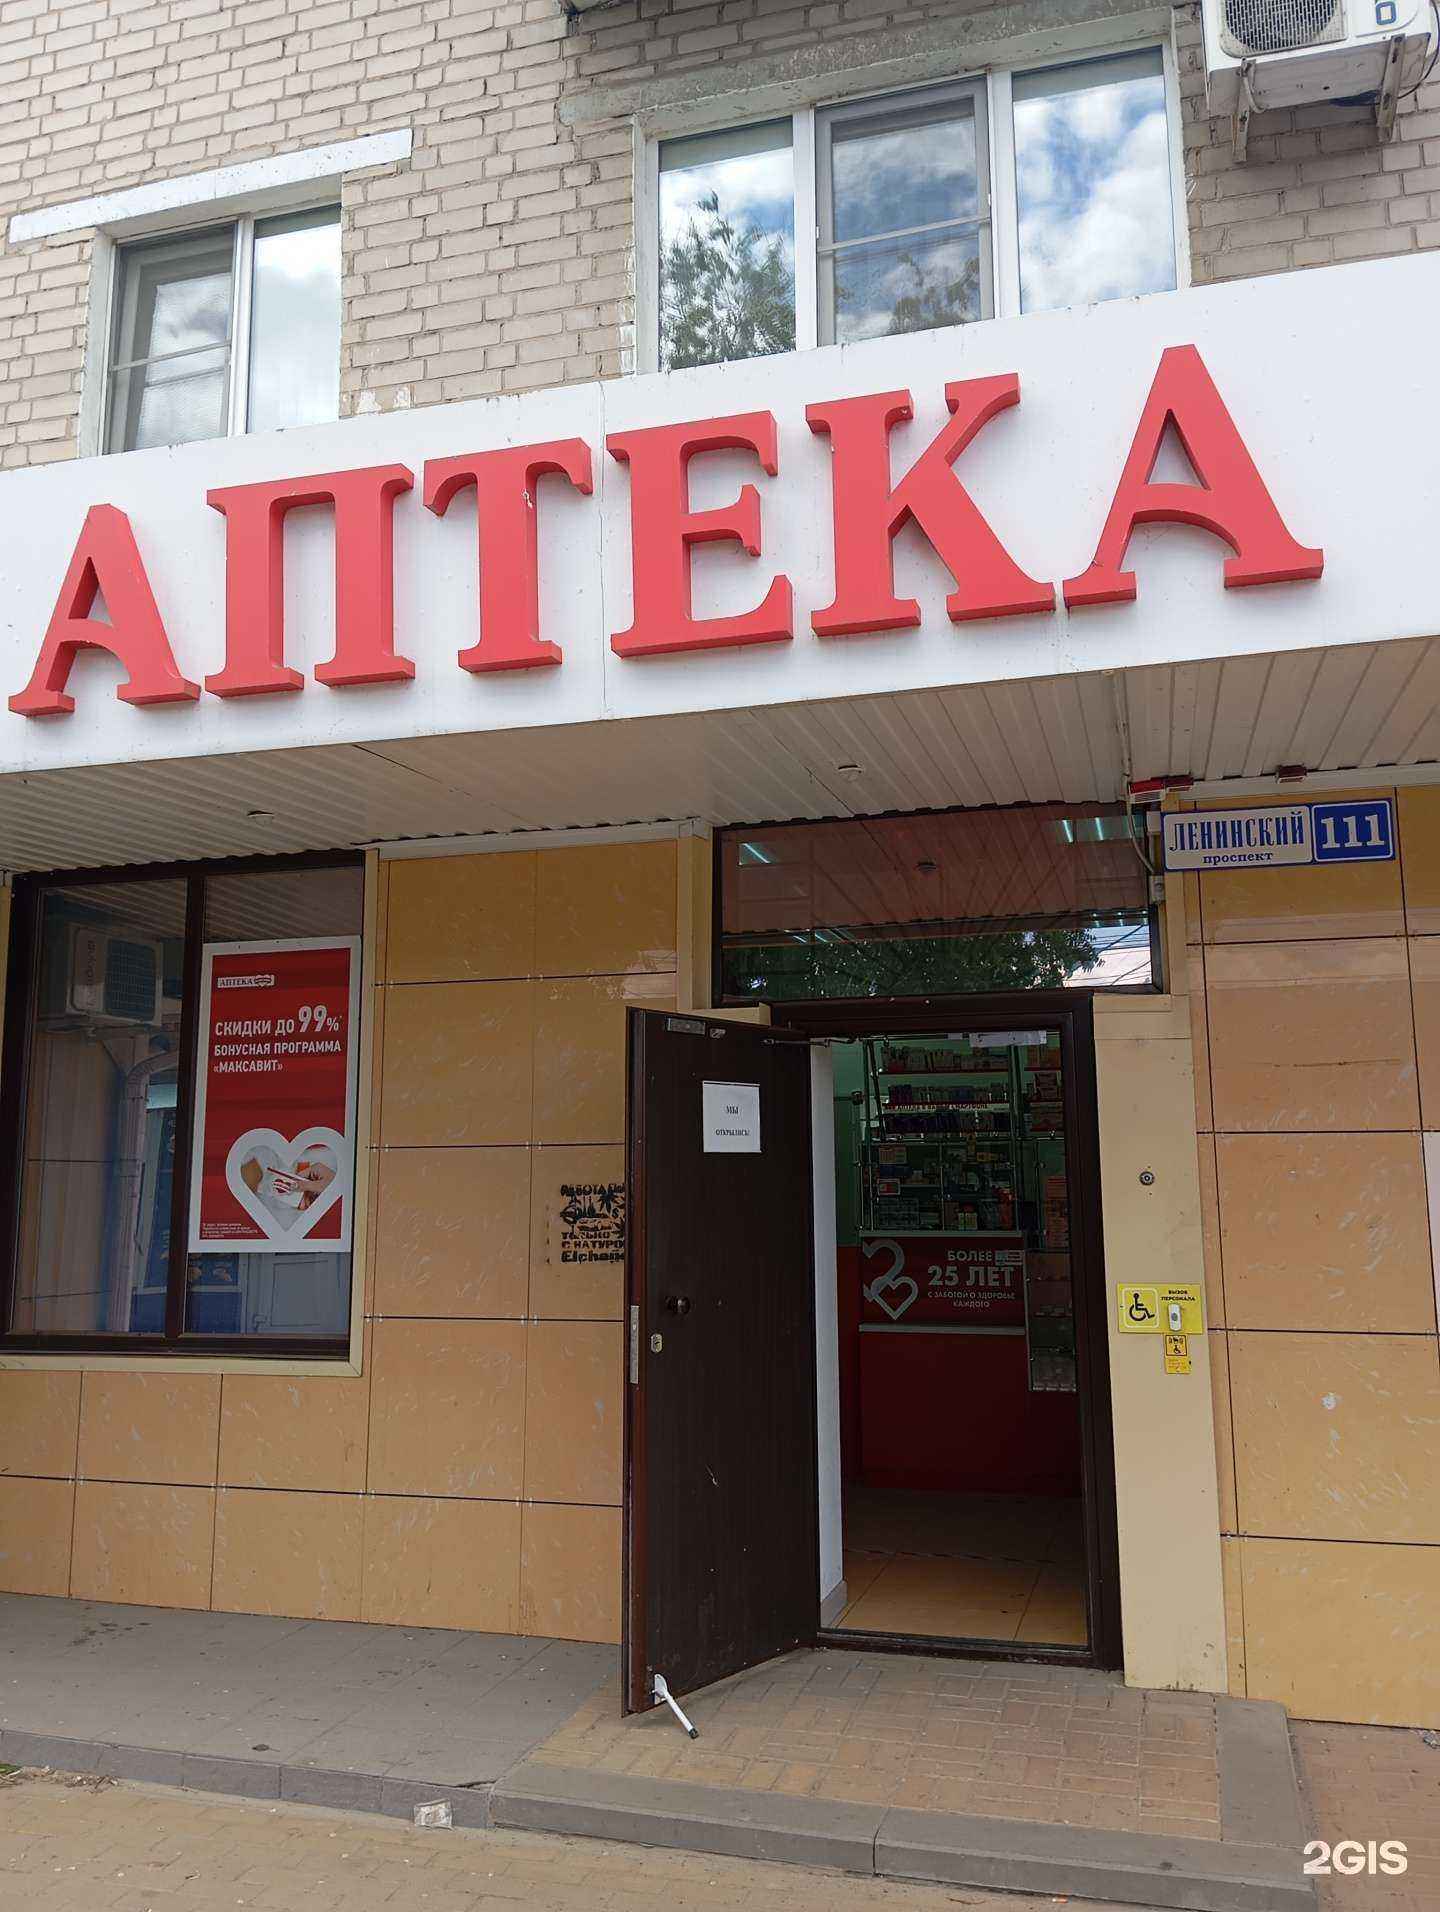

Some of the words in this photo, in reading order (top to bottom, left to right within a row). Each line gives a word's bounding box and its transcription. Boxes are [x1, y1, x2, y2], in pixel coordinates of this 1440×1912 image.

[8, 343, 1323, 717] АПТЕКА
[1169, 811, 1304, 851] ЛЕНИНСКИЙ
[1321, 814, 1385, 849] 111
[1203, 852, 1273, 865] проспект
[219, 977, 253, 987] АПТЕКА
[215, 1020, 271, 1037] СКИДКИ
[275, 1019, 294, 1036] ДО
[214, 1043, 271, 1056] БОНУСНАЯ
[274, 1040, 341, 1054] ПРОГРАММА
[213, 1059, 283, 1073] «МАКСАВИТ»
[947, 1250, 993, 1262] БОЛЕЕ
[928, 1265, 959, 1286] 25
[966, 1266, 1015, 1287] ЛЕТ
